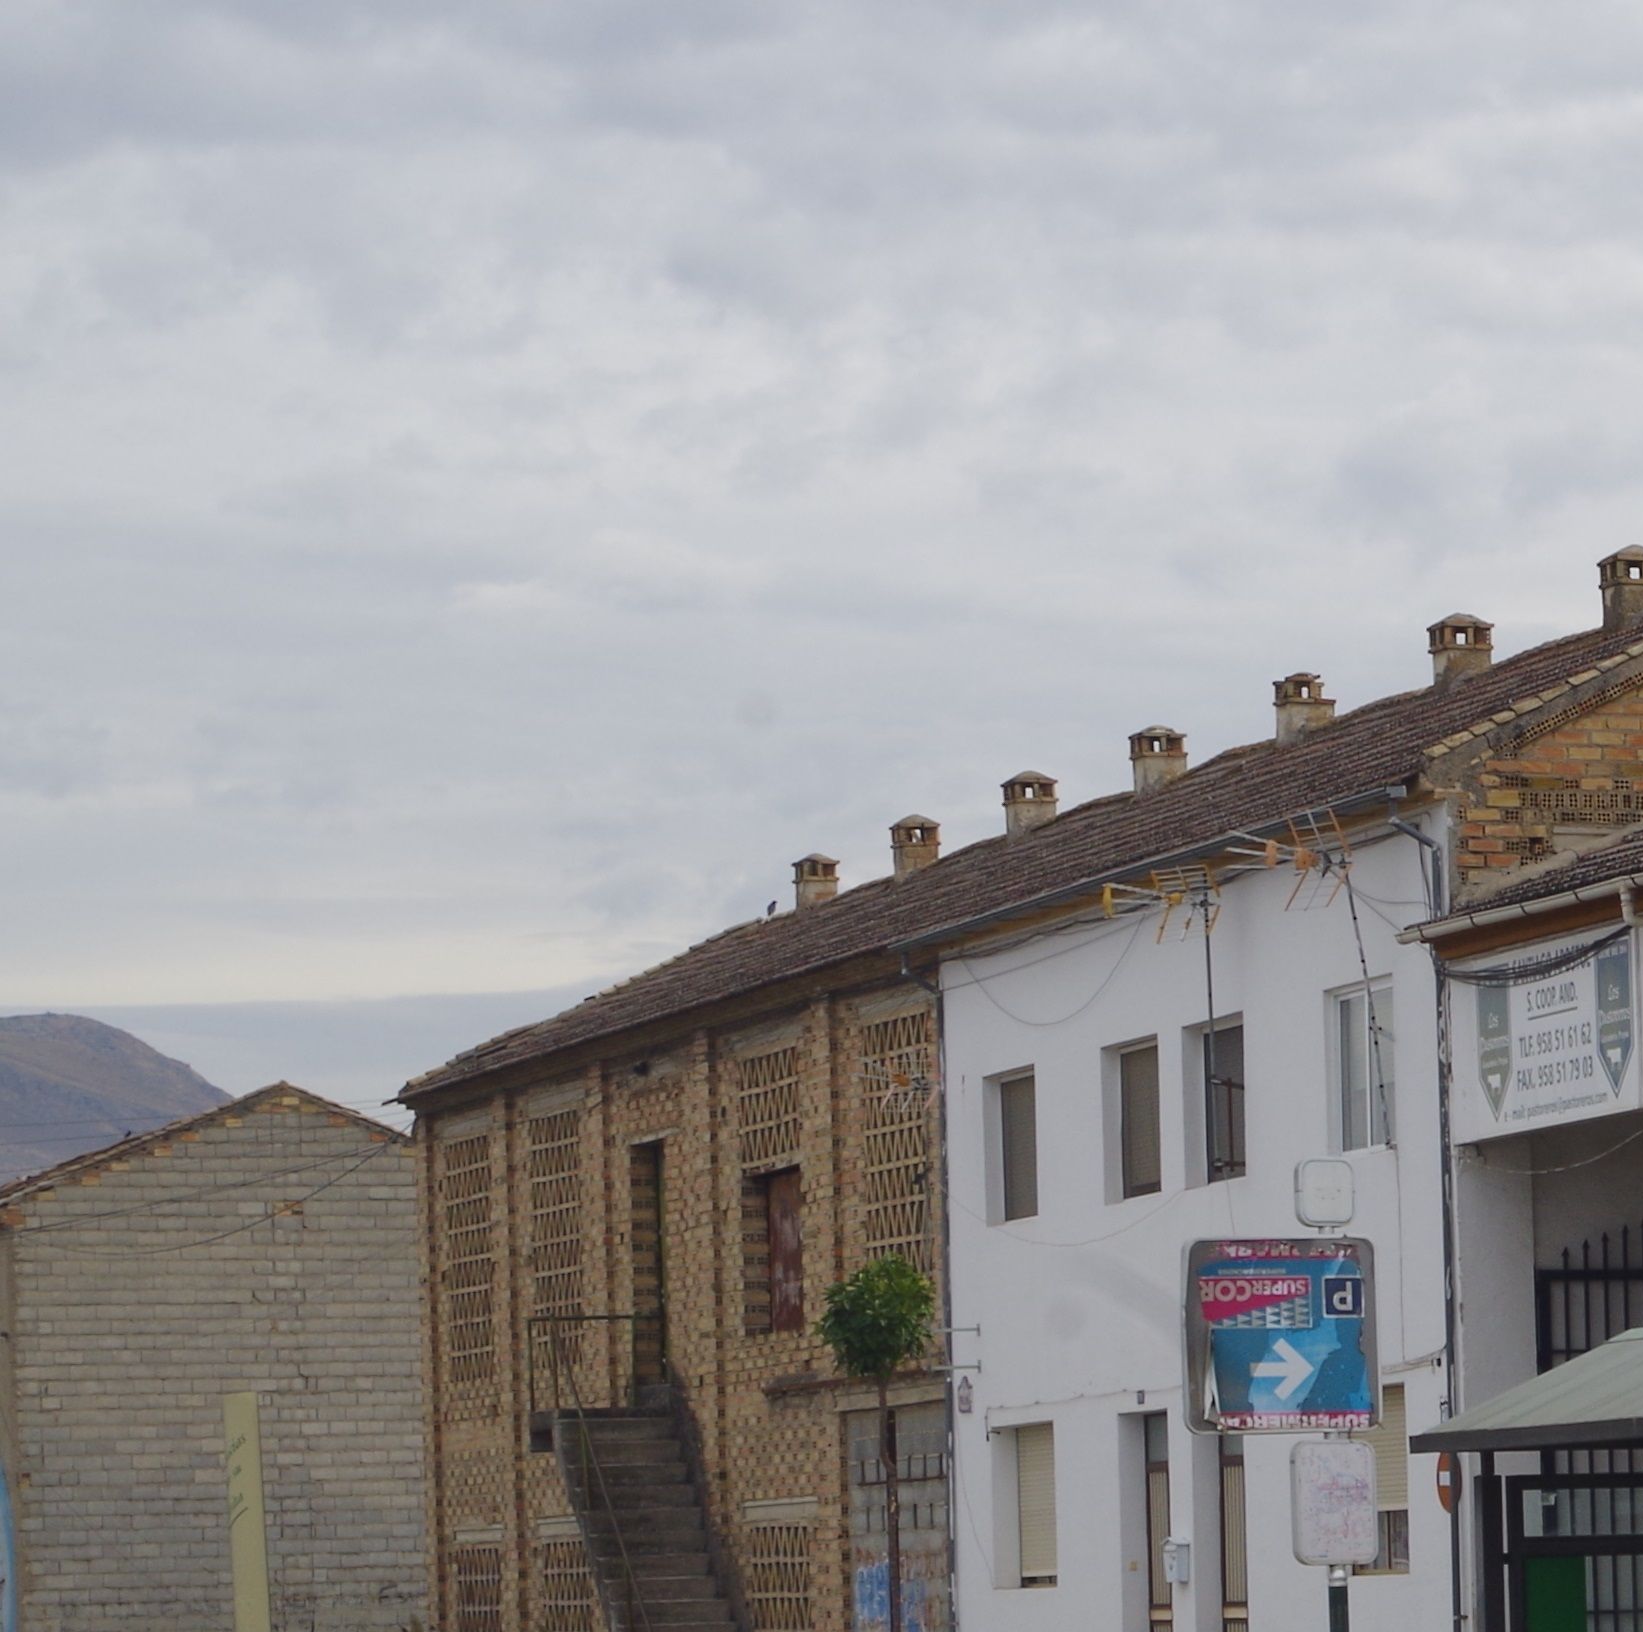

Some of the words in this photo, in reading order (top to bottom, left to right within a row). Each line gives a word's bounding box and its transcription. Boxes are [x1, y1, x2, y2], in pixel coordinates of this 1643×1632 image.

[1536, 1031, 1552, 1055] 958
[1555, 1028, 1565, 1051] 51
[1538, 1063, 1554, 1087] 958
[1556, 1061, 1566, 1083] 51
[1199, 1279, 1307, 1303] SUPERCOR
[1332, 1280, 1354, 1311] P
